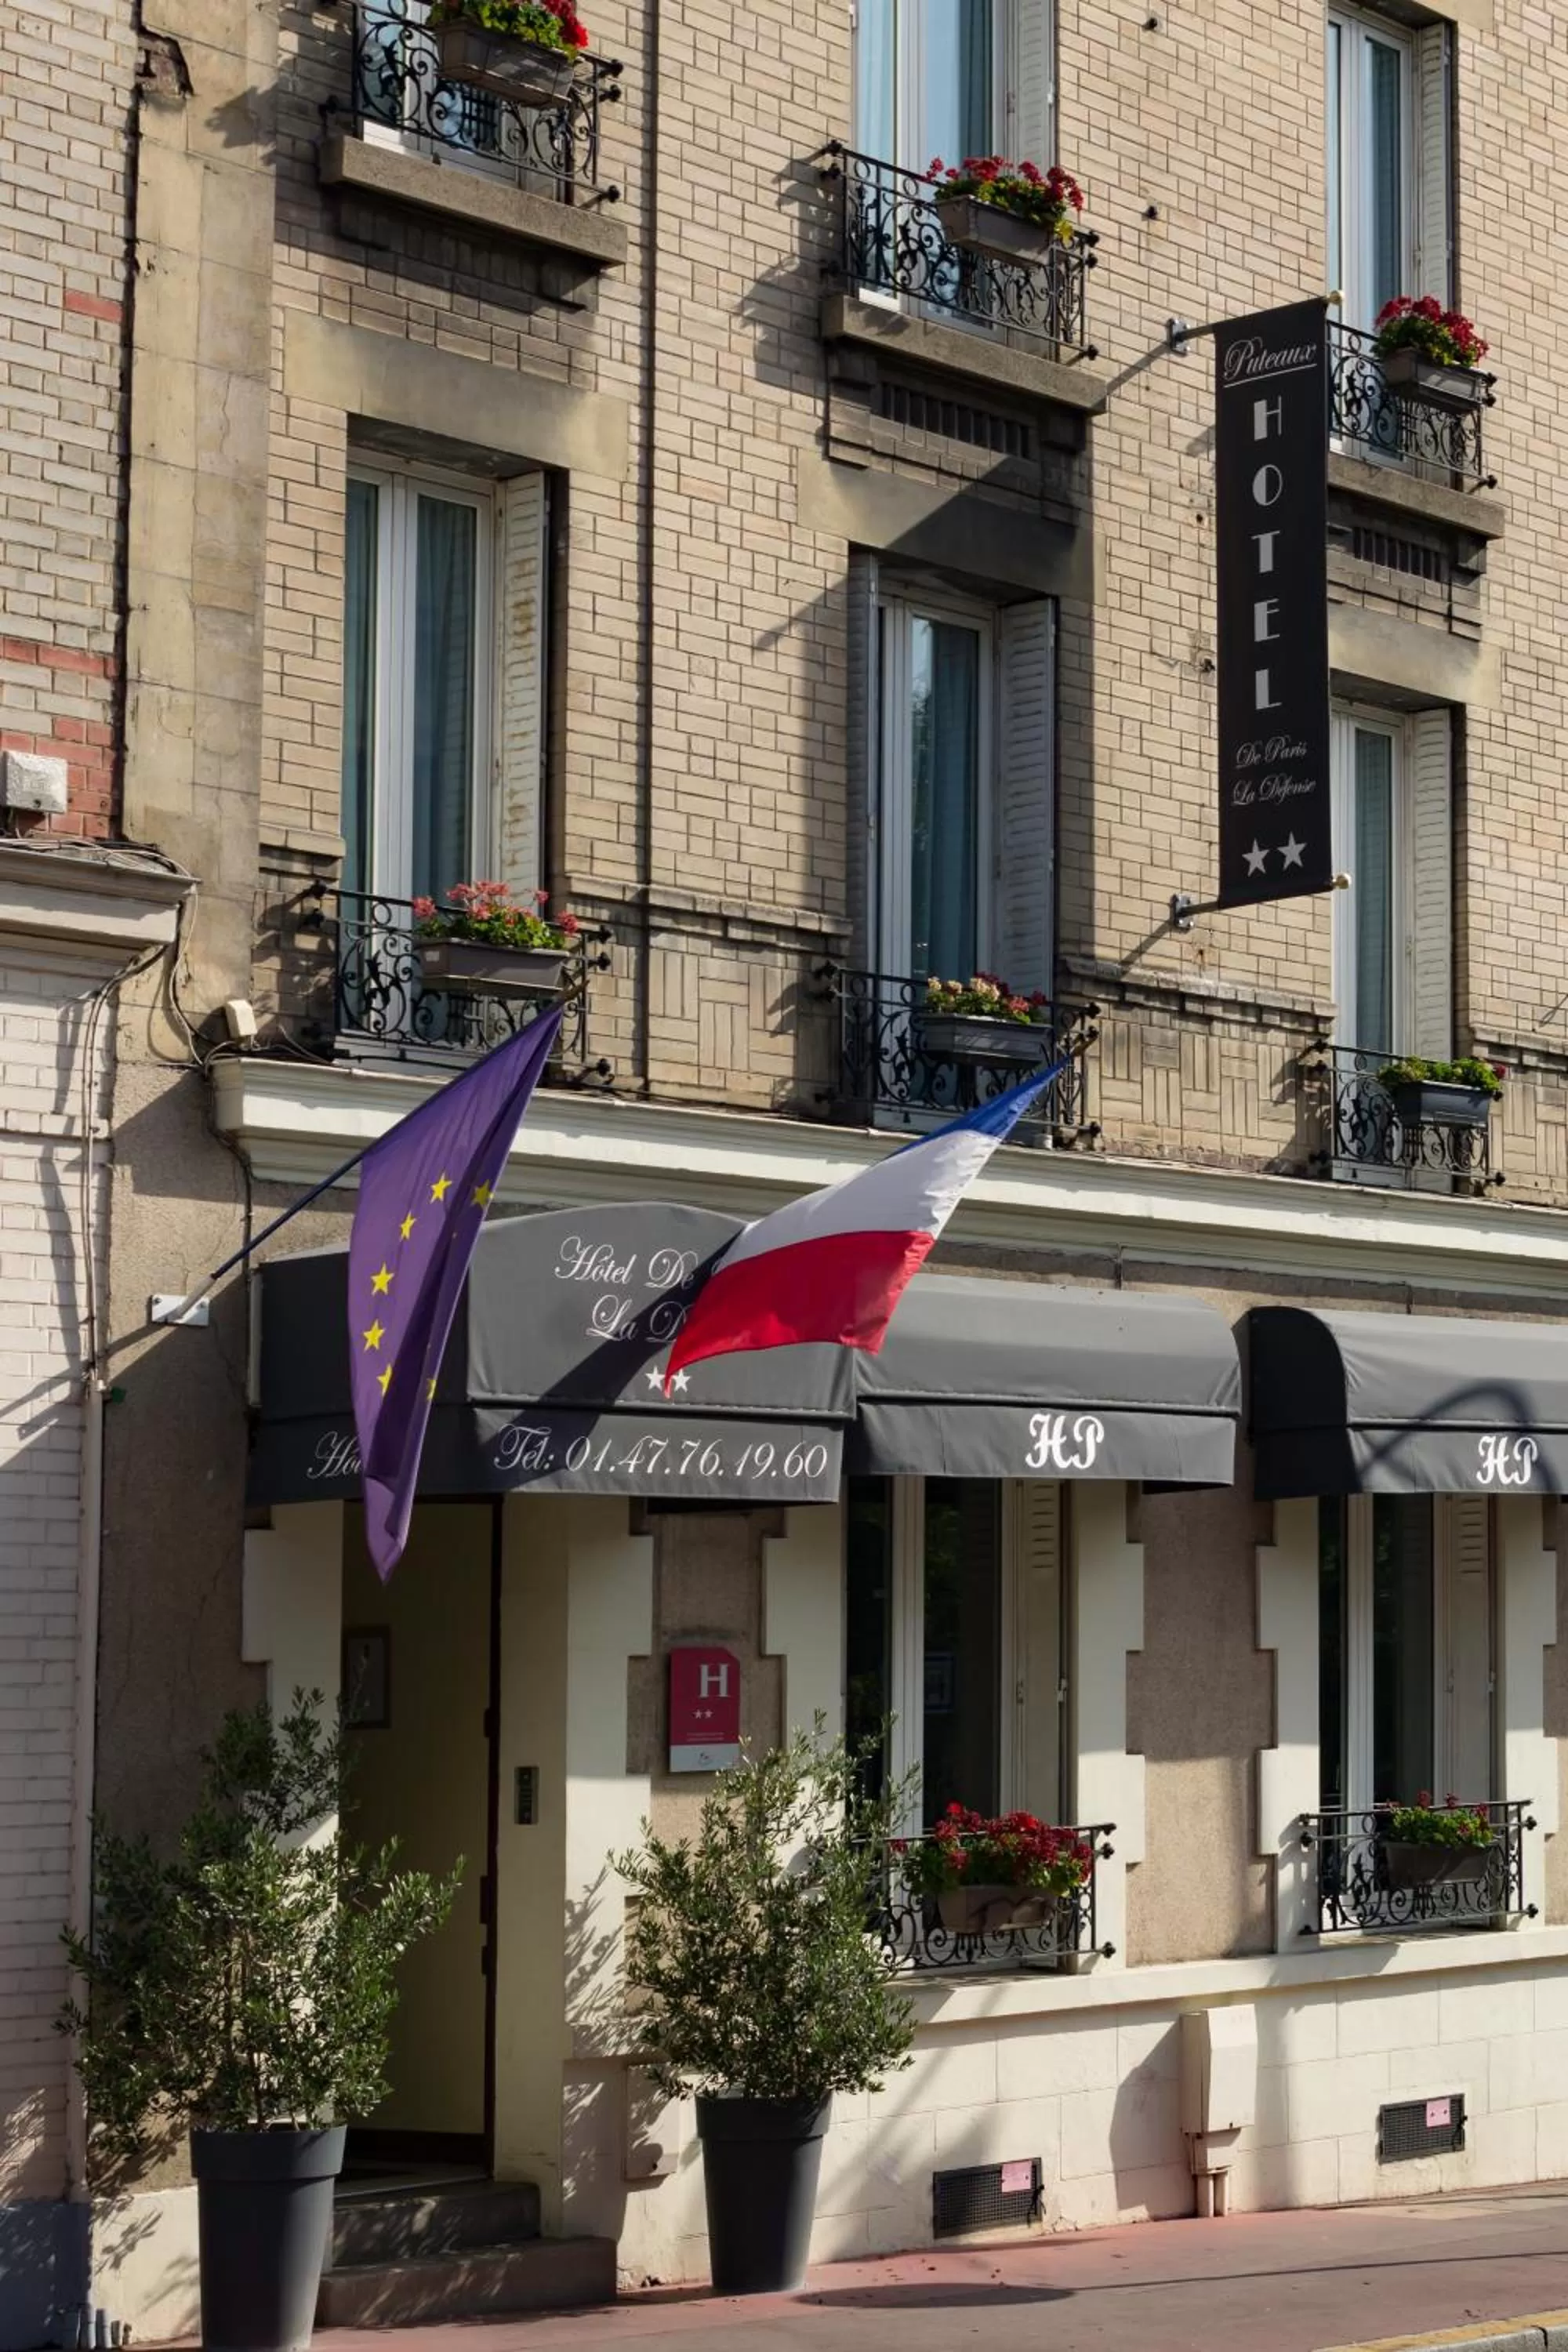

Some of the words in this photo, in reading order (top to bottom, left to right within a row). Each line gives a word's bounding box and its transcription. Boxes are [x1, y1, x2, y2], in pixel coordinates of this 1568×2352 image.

[1224, 336, 1317, 381] Puteaux
[1251, 395, 1283, 710] HOTEL
[1264, 735, 1308, 763] Paris
[1232, 781, 1254, 806] La
[554, 1236, 637, 1285] Hôtel
[644, 1248, 699, 1290] De
[586, 1294, 637, 1341] La
[565, 1427, 828, 1480] 01.47.76.19.60
[1025, 1414, 1105, 1469] HP
[1476, 1436, 1537, 1485] HP
[699, 1663, 730, 1698] H
